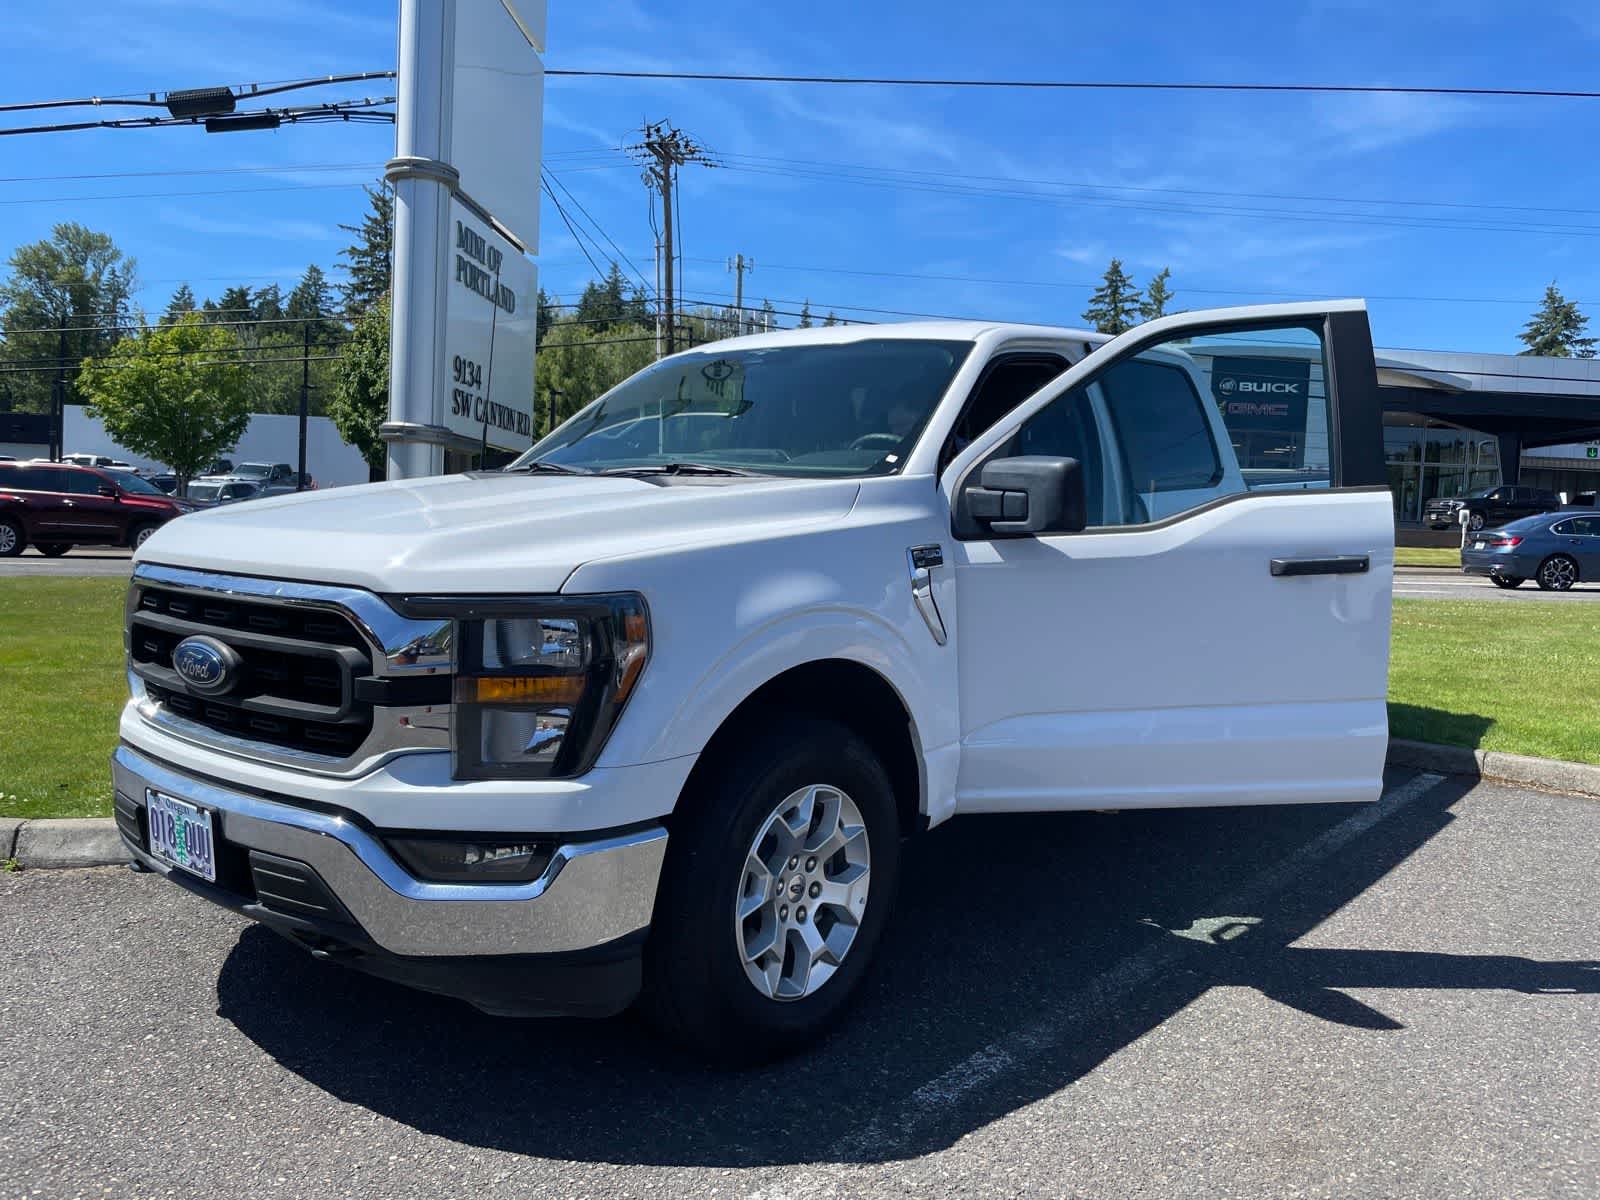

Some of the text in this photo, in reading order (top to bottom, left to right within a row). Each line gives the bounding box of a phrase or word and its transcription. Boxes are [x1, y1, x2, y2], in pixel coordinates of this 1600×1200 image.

[456, 220, 503, 274] MINI OF
[456, 254, 516, 315] PORTLAND
[453, 355, 482, 390] 9134
[1239, 382, 1299, 393] BUICK
[451, 387, 473, 419] SW
[473, 398, 516, 434] CANYON
[1227, 402, 1289, 416] GMC
[180, 651, 210, 678] Ford
